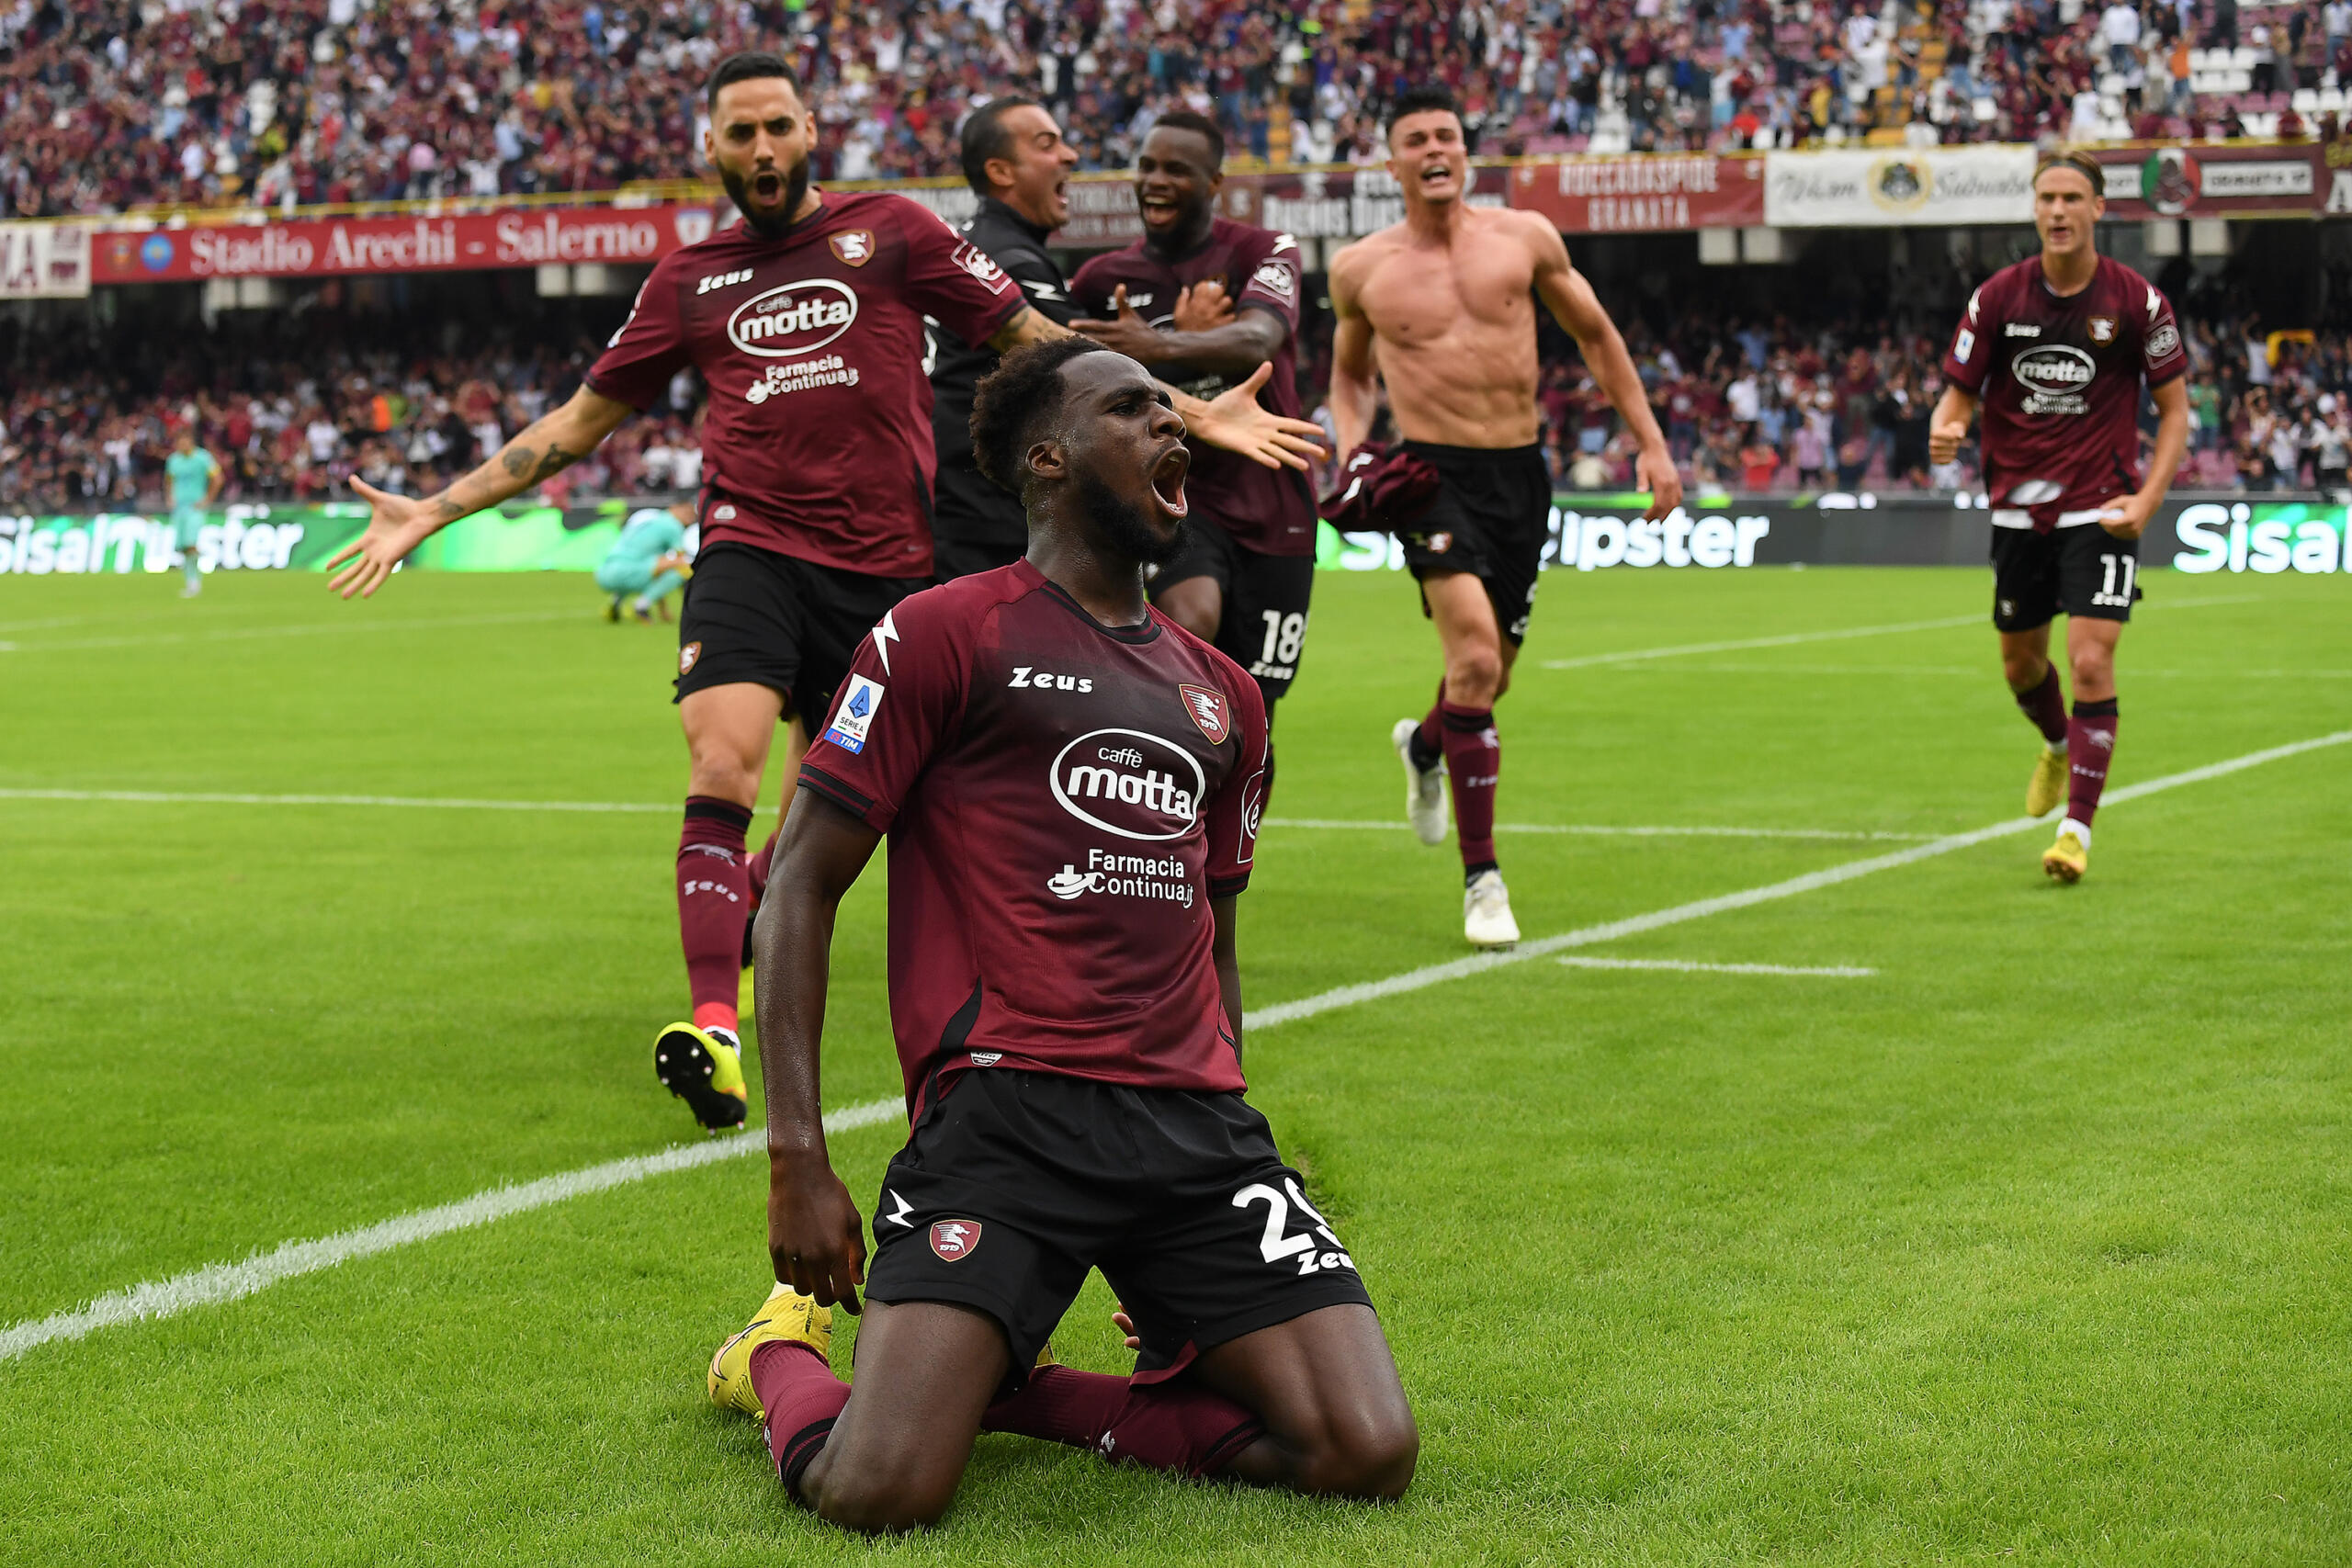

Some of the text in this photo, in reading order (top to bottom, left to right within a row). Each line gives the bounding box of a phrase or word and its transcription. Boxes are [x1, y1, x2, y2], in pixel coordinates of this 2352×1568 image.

[189, 226, 314, 275] Stadio
[323, 220, 457, 269] Arechi
[495, 212, 659, 263] Salerno
[696, 267, 754, 296] Zeus
[740, 298, 853, 343] motta
[765, 354, 844, 381] Farmacia
[2019, 360, 2089, 382] motta
[2100, 553, 2135, 595] 11
[1261, 609, 1304, 664] 18
[1007, 666, 1093, 694] Zeus
[840, 716, 860, 730] SERIE
[840, 736, 859, 750] TIM
[1098, 746, 1144, 769] caffè
[1067, 765, 1193, 820] motta
[1089, 849, 1185, 878] Farmacia
[1087, 873, 1193, 908] Continua.it
